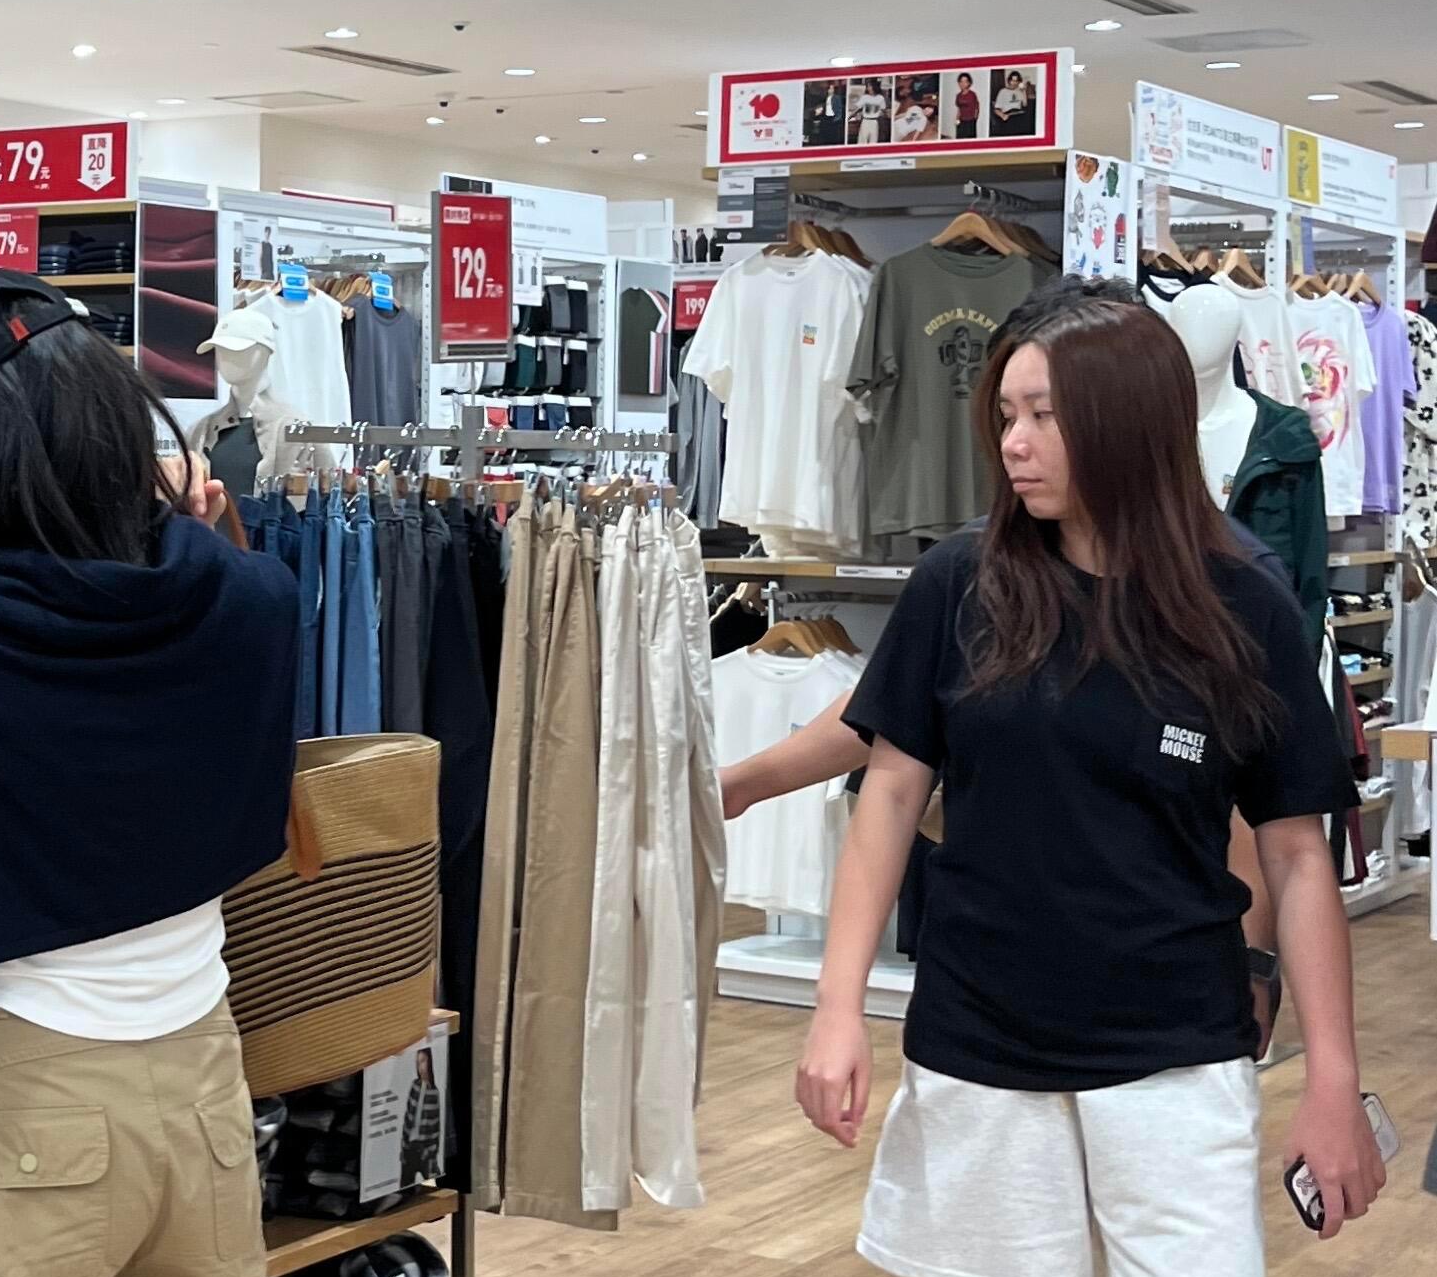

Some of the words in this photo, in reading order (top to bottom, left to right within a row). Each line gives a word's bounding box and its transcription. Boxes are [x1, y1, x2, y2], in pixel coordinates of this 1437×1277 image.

[88, 153, 105, 171] 20
[91, 174, 102, 185] 元
[685, 297, 706, 315] 199
[1163, 724, 1207, 748] MICKEY
[1160, 739, 1205, 764] MOUSE
